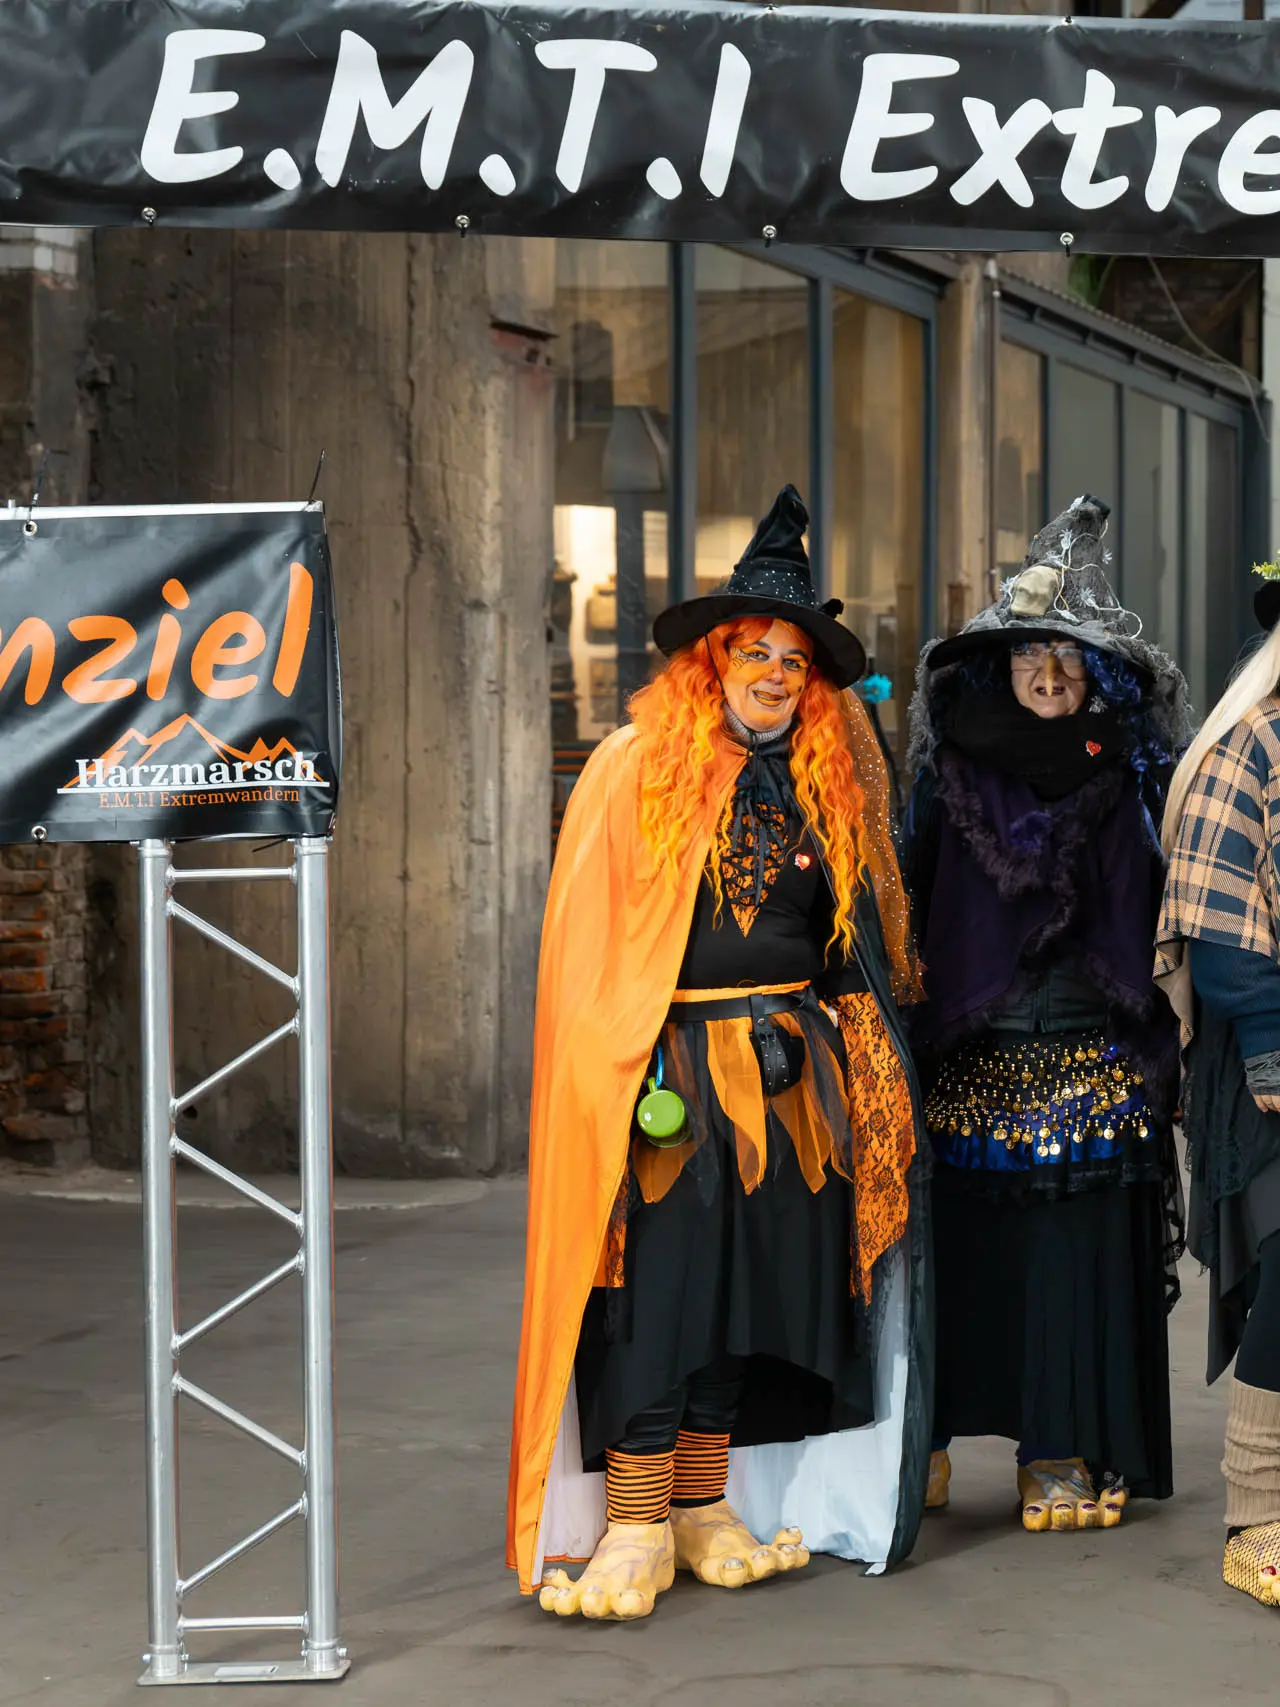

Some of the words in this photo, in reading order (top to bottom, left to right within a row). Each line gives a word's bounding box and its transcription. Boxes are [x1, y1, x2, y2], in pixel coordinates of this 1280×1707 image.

[140, 29, 752, 200] E.M.T.I
[76, 752, 316, 788] Harzmarsch
[160, 785, 300, 808] Extremwandern
